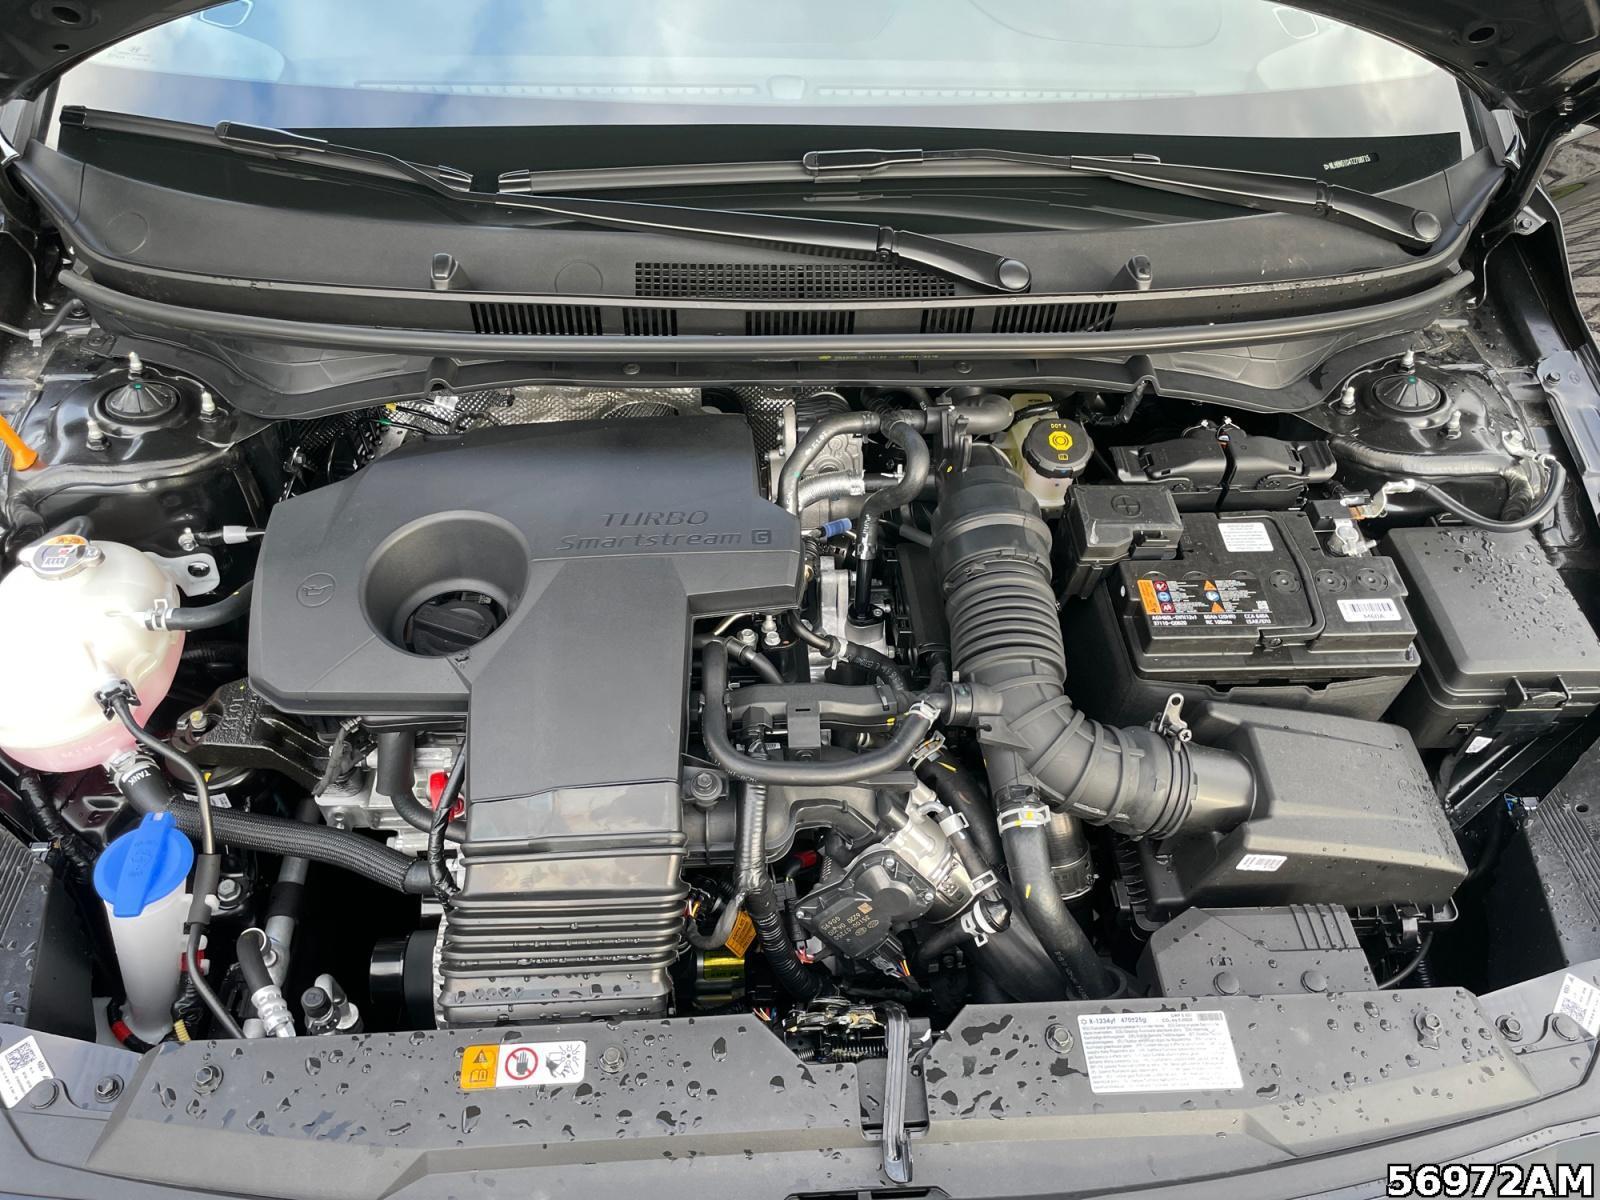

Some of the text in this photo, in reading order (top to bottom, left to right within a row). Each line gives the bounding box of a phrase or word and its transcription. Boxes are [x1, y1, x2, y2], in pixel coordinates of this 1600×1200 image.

[600, 510, 709, 527] TURBO
[554, 532, 742, 550] Smartstream
[128, 769, 151, 786] TANK
